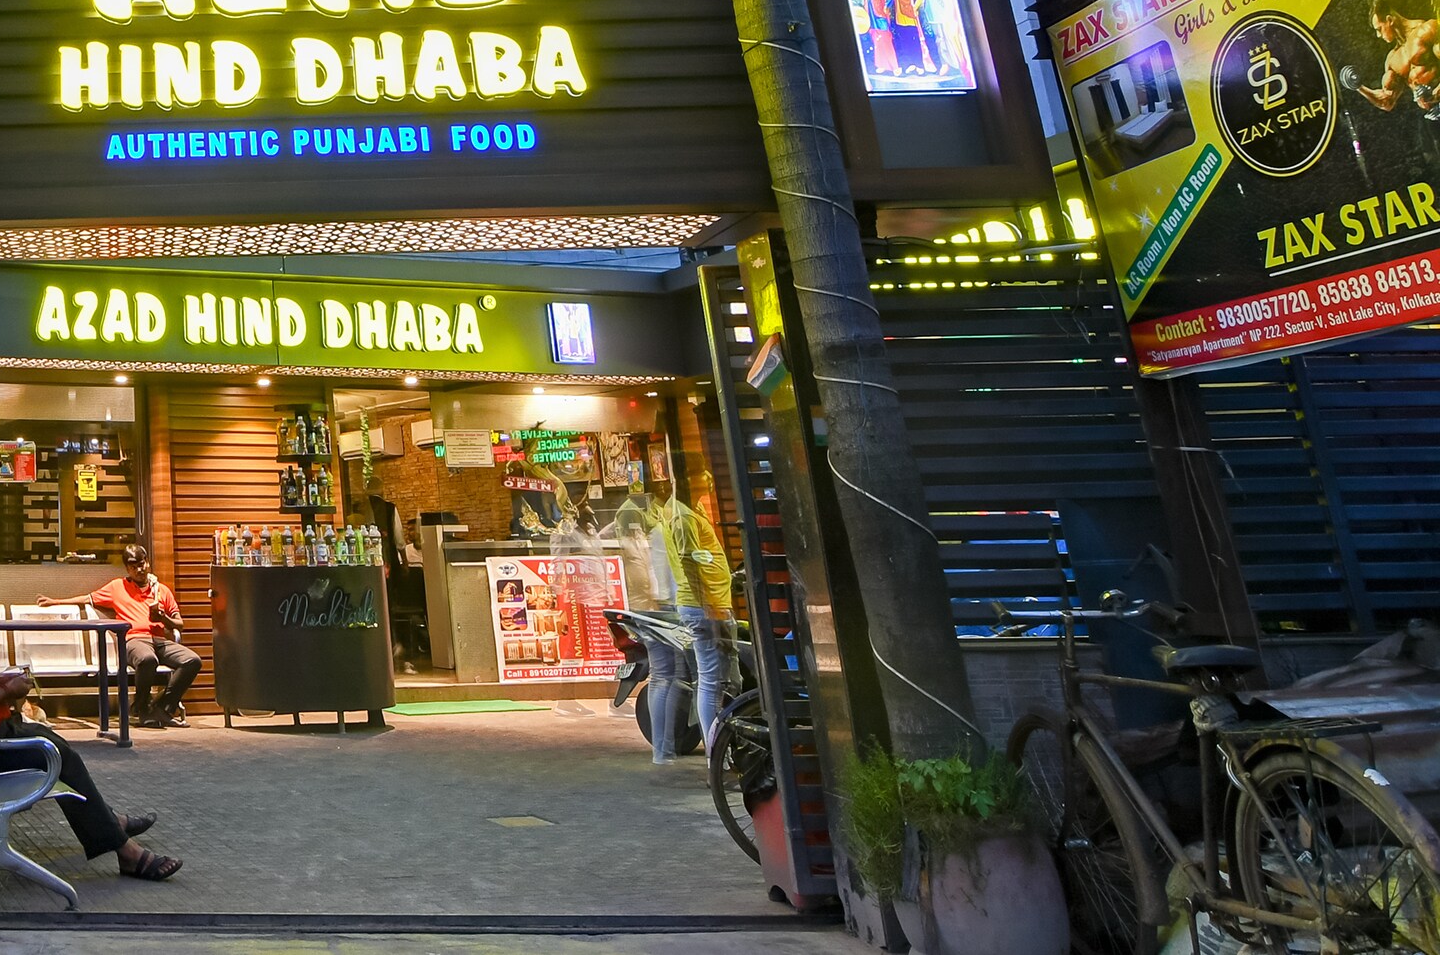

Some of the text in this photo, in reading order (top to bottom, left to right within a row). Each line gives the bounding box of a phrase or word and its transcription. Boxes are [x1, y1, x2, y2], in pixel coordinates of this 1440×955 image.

[1057, 10, 1109, 60] ZAX
[1174, 3, 1215, 44] Girls
[59, 26, 587, 112] HIND DHABA
[106, 123, 536, 160] AUTHENTIC PUNJABI FOOD
[1237, 99, 1326, 145] ZAX STAR
[1128, 271, 1144, 294] AC
[1137, 240, 1162, 276] Room
[1161, 208, 1182, 236] Non
[1177, 188, 1194, 212] AC
[1189, 152, 1219, 191] Room
[1257, 182, 1440, 268] ZAX STAR
[36, 286, 166, 344] AZAD
[184, 292, 307, 347] HIND
[320, 298, 484, 354] DHABA
[1155, 314, 1207, 343] Contact
[1216, 289, 1318, 329] 9830057720,
[1318, 274, 1373, 306] 85838
[1249, 326, 1261, 342] NP
[1264, 321, 1284, 339] 222,
[1285, 314, 1327, 336] Sector-V,
[1327, 309, 1348, 327] Salt
[1351, 304, 1374, 322] Lake
[1375, 299, 1400, 317] City,
[504, 480, 551, 490] OPEN
[507, 670, 522, 678] Call
[529, 668, 578, 677] 8910207575
[584, 666, 617, 675] 8100407
